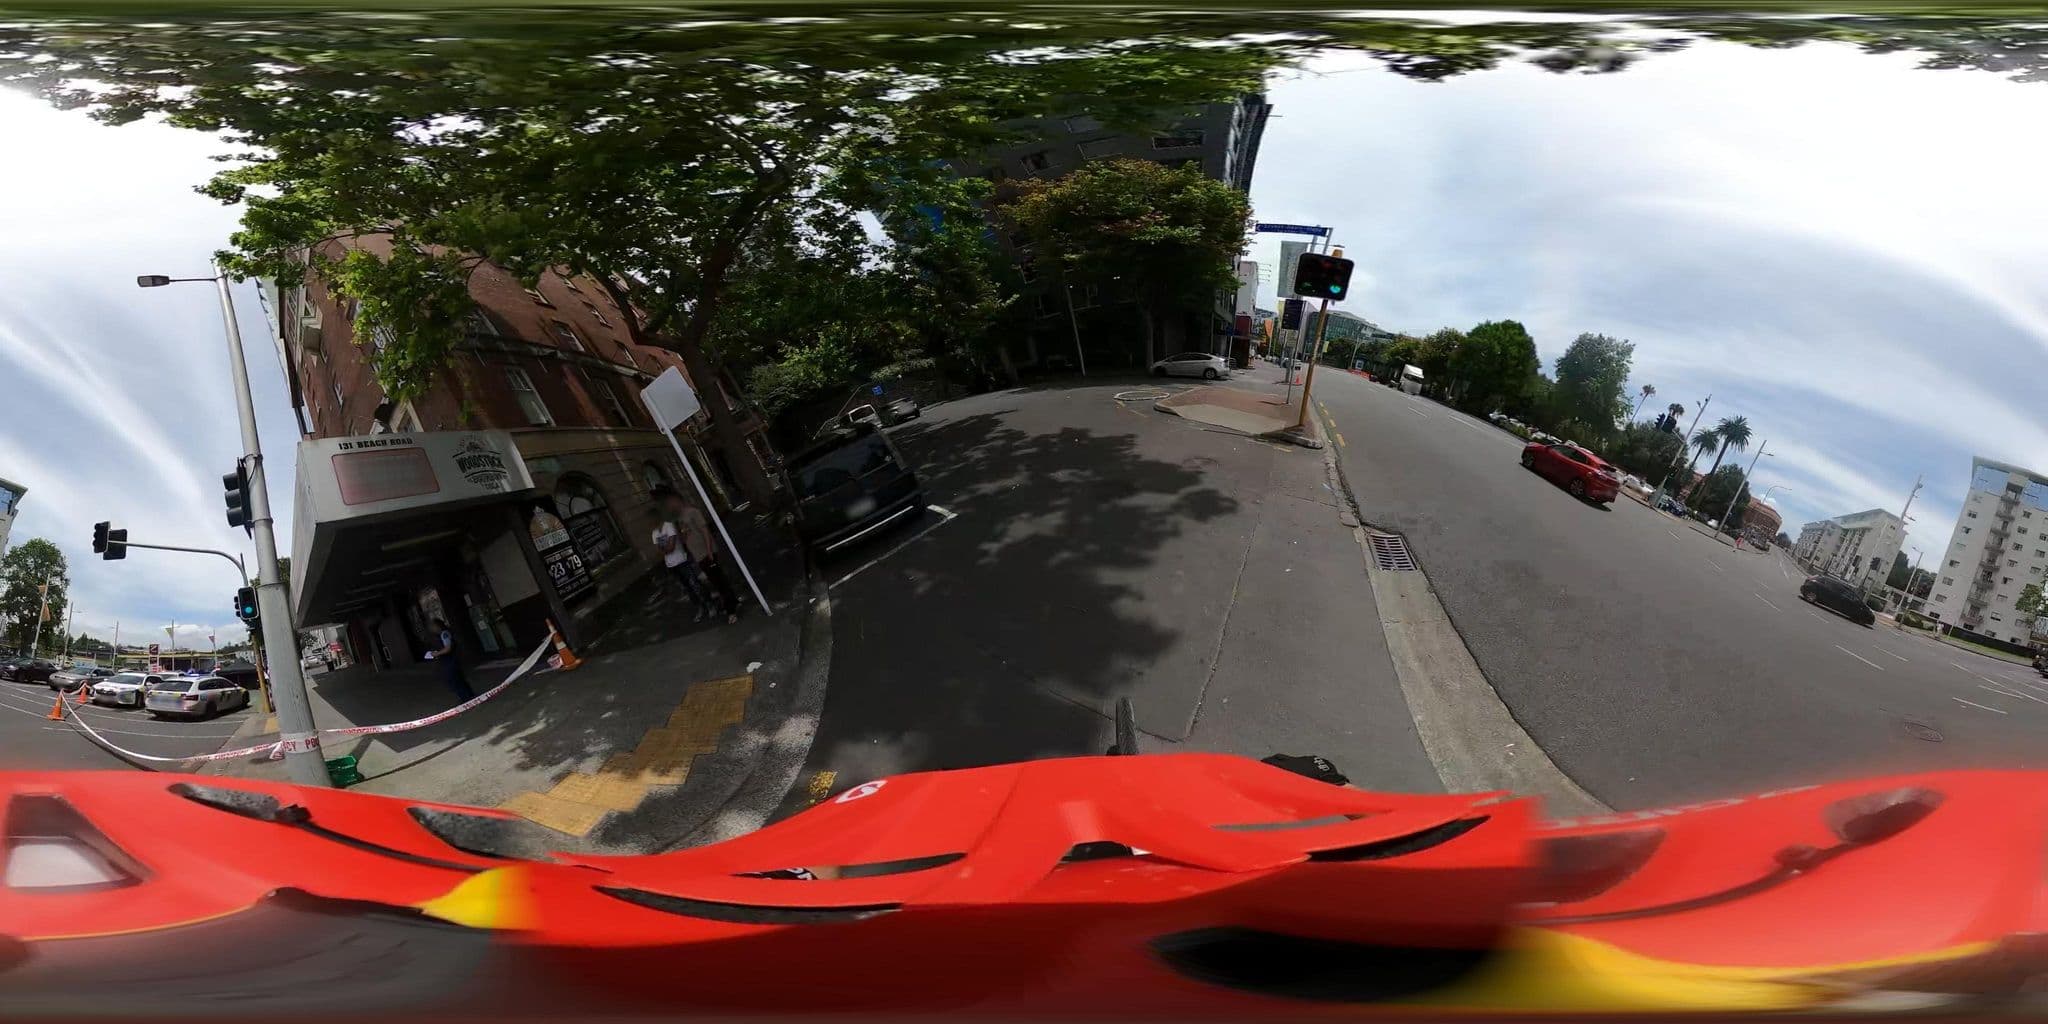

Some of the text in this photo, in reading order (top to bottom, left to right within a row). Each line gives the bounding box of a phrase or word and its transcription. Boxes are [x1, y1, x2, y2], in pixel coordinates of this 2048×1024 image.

[338, 438, 413, 450] 131 BEACH ROAD
[456, 455, 505, 473] WOODSTOCK
